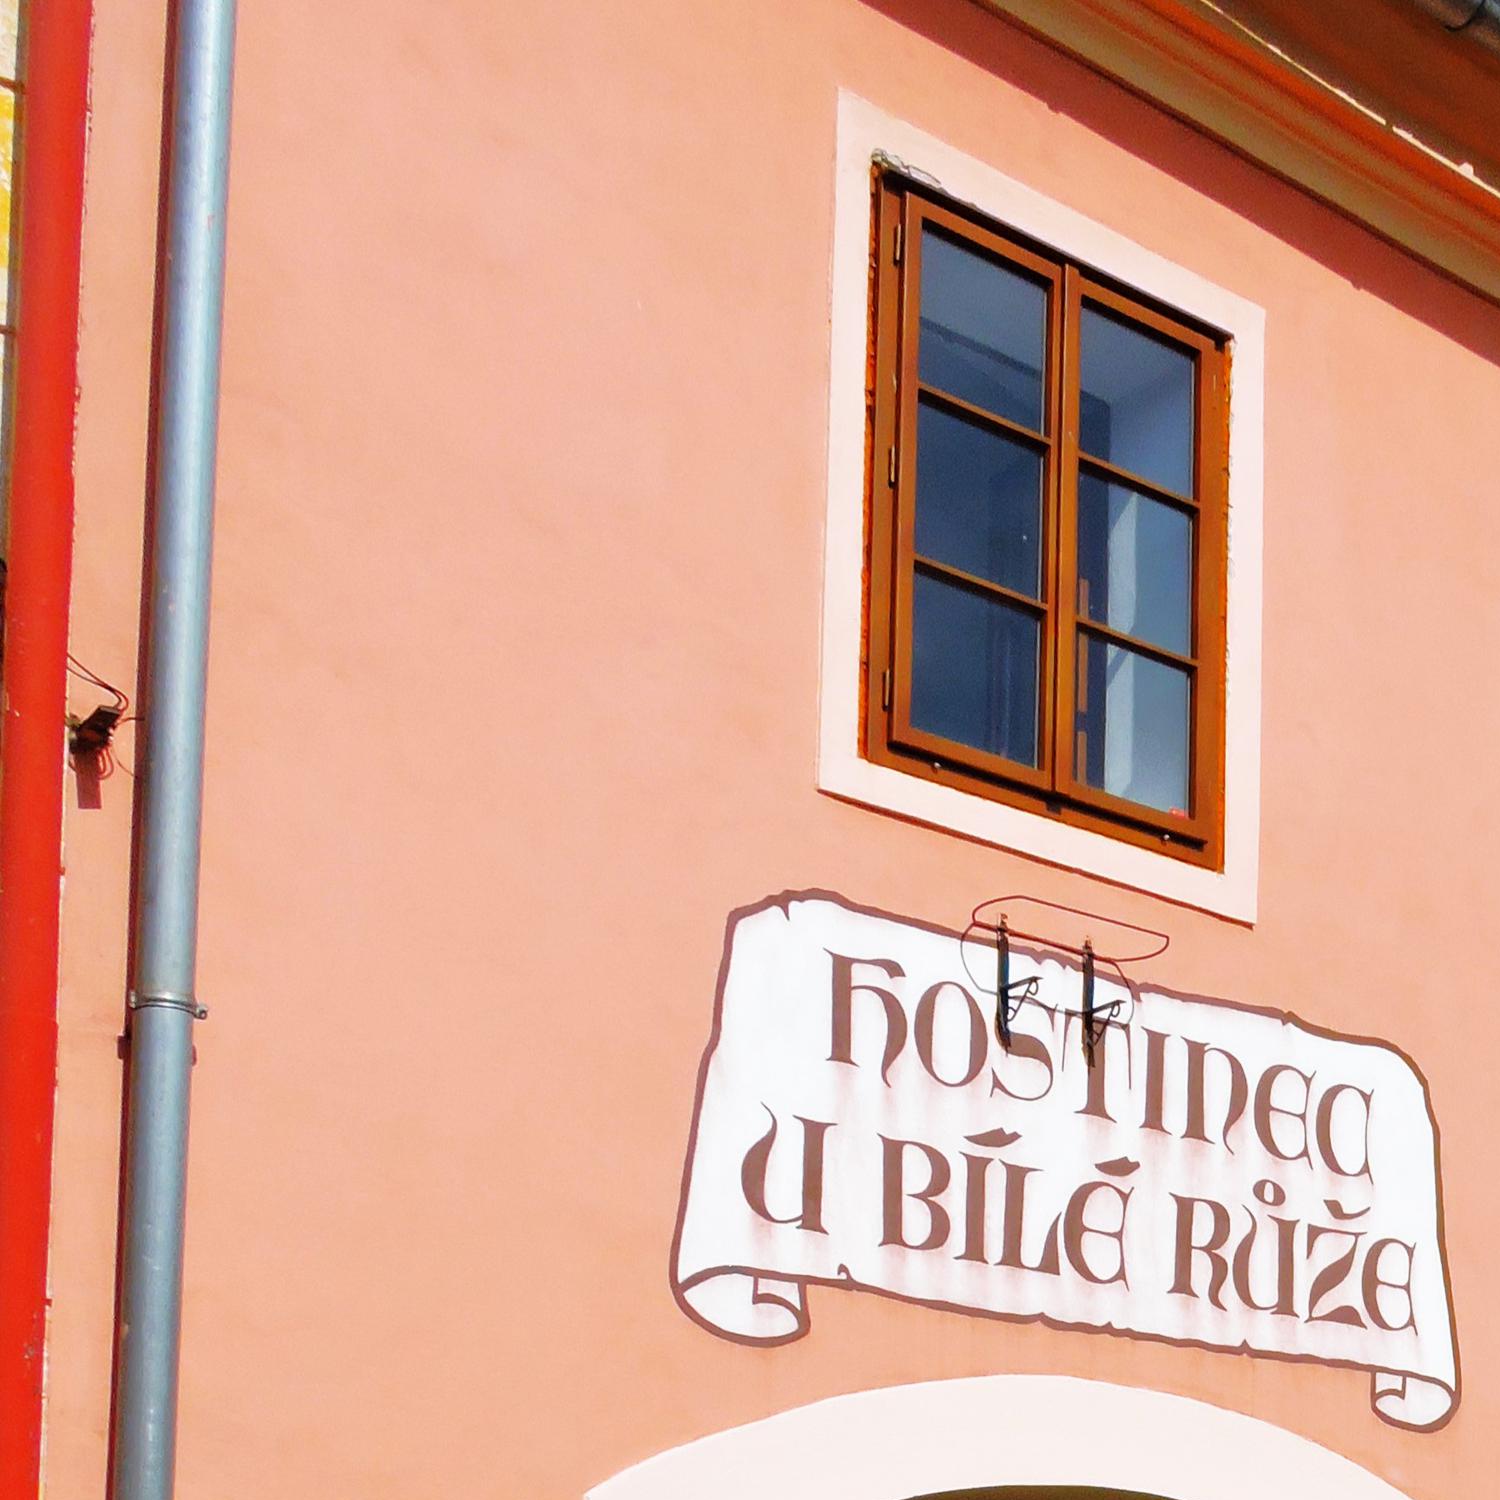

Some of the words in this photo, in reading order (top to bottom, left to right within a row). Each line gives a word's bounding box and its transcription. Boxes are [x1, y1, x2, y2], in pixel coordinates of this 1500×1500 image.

[822, 946, 1375, 1185] HOSTINEC
[740, 1102, 837, 1235] U
[877, 1127, 1142, 1293] BÍLÉ
[1166, 1178, 1418, 1338] RŮŽE
